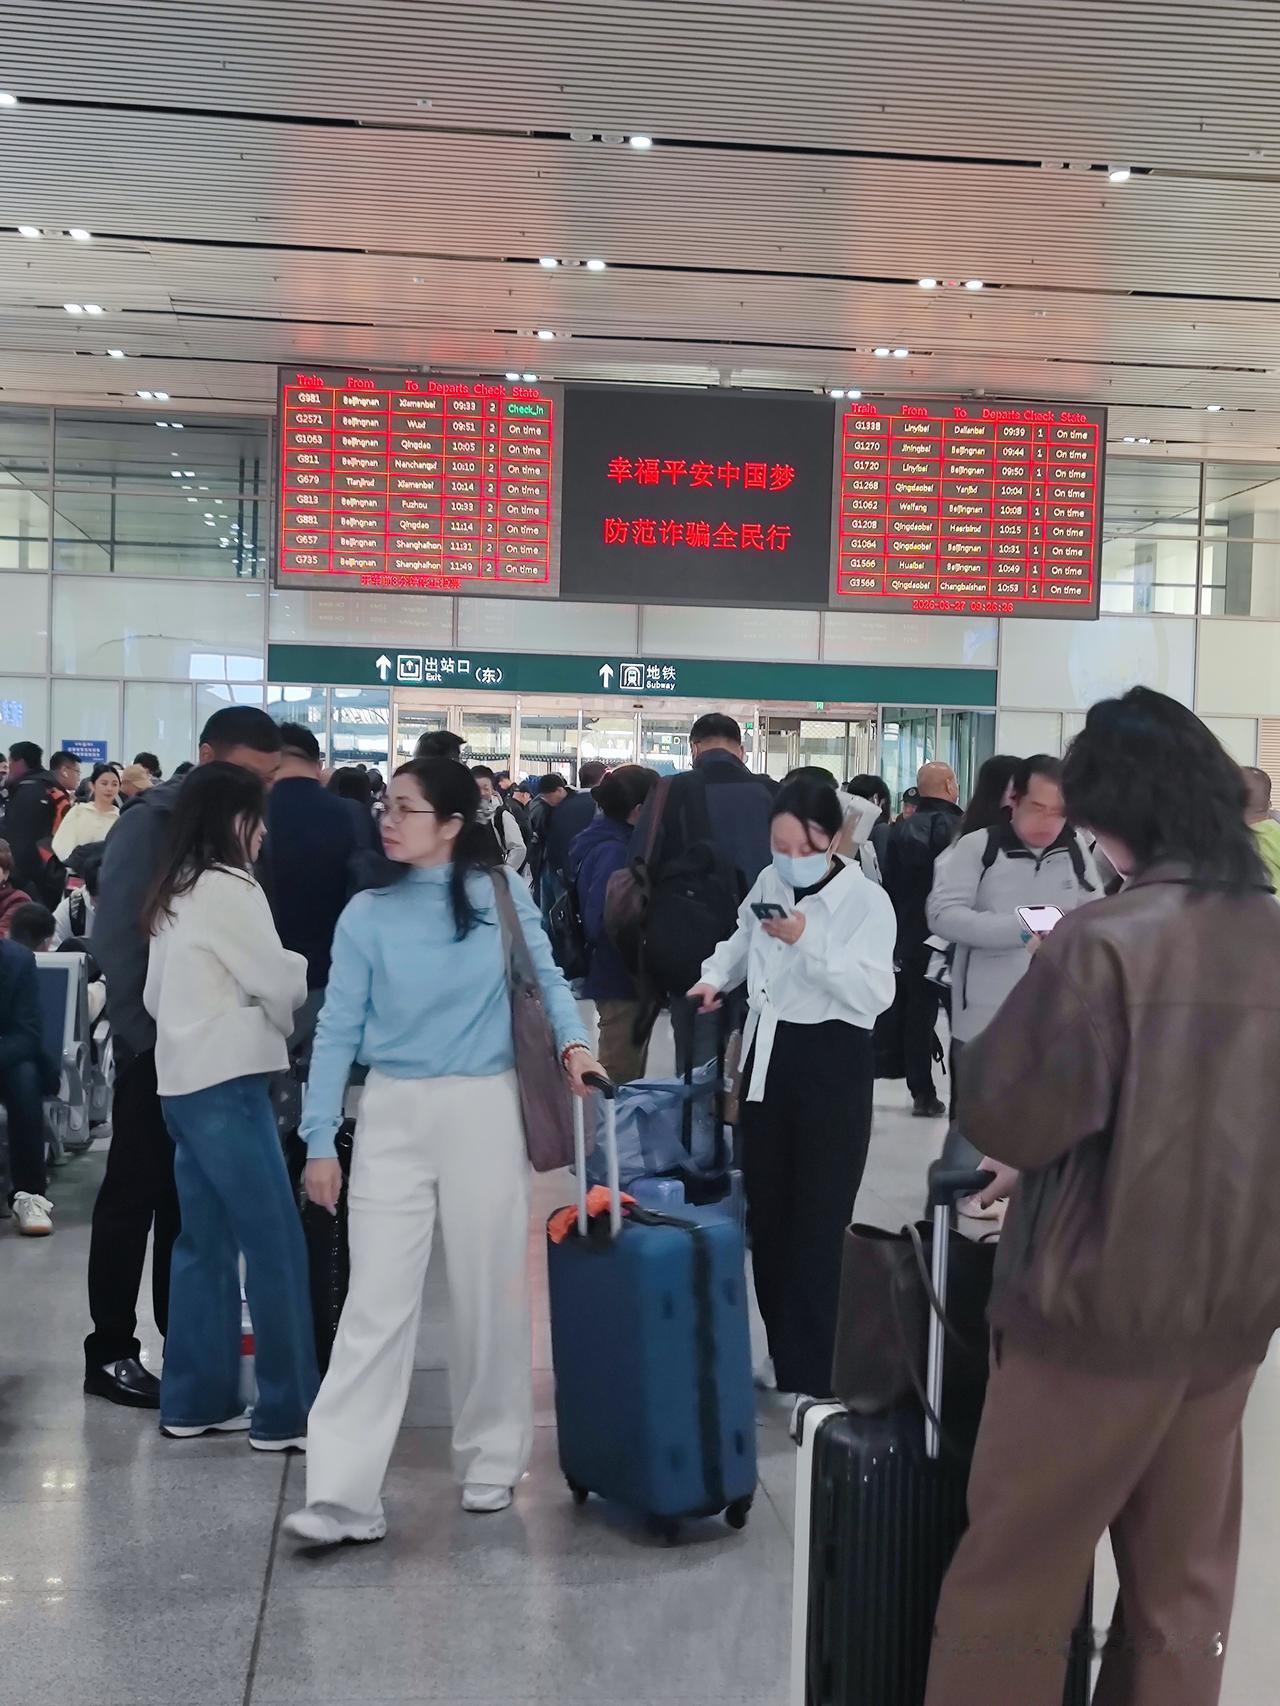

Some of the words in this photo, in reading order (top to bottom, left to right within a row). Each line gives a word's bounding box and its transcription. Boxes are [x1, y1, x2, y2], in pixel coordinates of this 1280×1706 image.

[297, 375, 324, 386] Train
[347, 377, 375, 389] From
[405, 380, 419, 391] To
[474, 385, 506, 396] Check
[512, 387, 539, 398] State
[453, 400, 476, 411] 09:33
[489, 402, 496, 413] 2
[852, 403, 877, 413] Train
[902, 405, 928, 416] From
[954, 408, 967, 417] To
[1024, 411, 1054, 421] Check
[1060, 412, 1087, 422] State
[295, 413, 324, 425] G2571
[452, 421, 476, 432] 09:51
[489, 423, 496, 433] 2
[508, 424, 521, 434] On
[522, 425, 542, 436] time
[1003, 427, 1026, 437] 09:39
[1037, 428, 1043, 438] 1
[1056, 429, 1068, 439] On
[1069, 429, 1088, 440] time
[452, 441, 476, 452] 10:05
[488, 443, 495, 453] 2
[508, 444, 521, 454] On
[522, 444, 541, 456] time
[854, 441, 881, 451] G1270
[1002, 447, 1025, 457] 09:44
[1037, 448, 1043, 458] 1
[1055, 449, 1068, 459] On
[1069, 449, 1088, 460] time
[297, 453, 320, 465] G811
[452, 461, 475, 472] 10:10
[488, 463, 494, 473] 2
[507, 464, 520, 474] On
[521, 464, 541, 476] time
[853, 460, 880, 471] G1720
[1001, 466, 1024, 477] 09:50
[1036, 468, 1042, 477] 1
[1055, 469, 1067, 478] On
[1068, 469, 1087, 479] time
[607, 456, 796, 491] 幸福平安中国梦
[451, 481, 474, 492] 10:14
[487, 483, 494, 493] 2
[507, 484, 520, 496] On
[521, 484, 540, 495] time
[1001, 486, 1023, 496] 10:04
[1035, 487, 1041, 497] 1
[1054, 488, 1066, 498] On
[1067, 488, 1086, 499] time
[296, 494, 319, 505] G813
[451, 501, 474, 512] 10:33
[487, 503, 494, 513] 2
[506, 504, 519, 515] On
[520, 504, 540, 515] time
[852, 499, 878, 510] G1062
[1000, 505, 1023, 515] 10:08
[1034, 507, 1040, 516] 1
[1053, 507, 1065, 517] On
[1066, 508, 1085, 518] time
[450, 521, 474, 532] 11:14
[486, 523, 493, 533] 2
[506, 524, 519, 536] On
[520, 524, 539, 536] time
[604, 517, 792, 550] 防范诈骗全民行
[851, 519, 878, 529] G1208
[999, 525, 1022, 535] 10:15
[1034, 526, 1040, 535] 1
[1052, 527, 1065, 536] On
[1066, 527, 1084, 537] time
[450, 541, 473, 552] 11:31
[486, 543, 493, 553] 2
[506, 544, 518, 554] On
[519, 544, 539, 556] time
[998, 544, 1021, 554] 10:31
[1033, 545, 1039, 555] 1
[1051, 546, 1064, 556] On
[1065, 546, 1083, 557] time
[295, 554, 318, 565] G735
[449, 561, 473, 572] 11:49
[486, 563, 492, 573] 2
[505, 564, 519, 576] On
[519, 564, 539, 575] time
[850, 558, 876, 568] G1566
[998, 564, 1021, 574] 10:49
[1032, 565, 1038, 574] 1
[1051, 566, 1063, 575] On
[1064, 566, 1083, 576] time
[997, 583, 1019, 593] 10:53
[1031, 584, 1037, 594] 1
[1050, 585, 1062, 594] On
[1063, 585, 1082, 595] time
[912, 600, 965, 610] 2026-03-27
[970, 602, 1014, 612] 09:26:26
[425, 657, 470, 673] 出站口
[646, 664, 677, 680] 地铁
[426, 673, 442, 682] Exit
[646, 680, 675, 690] Subway
